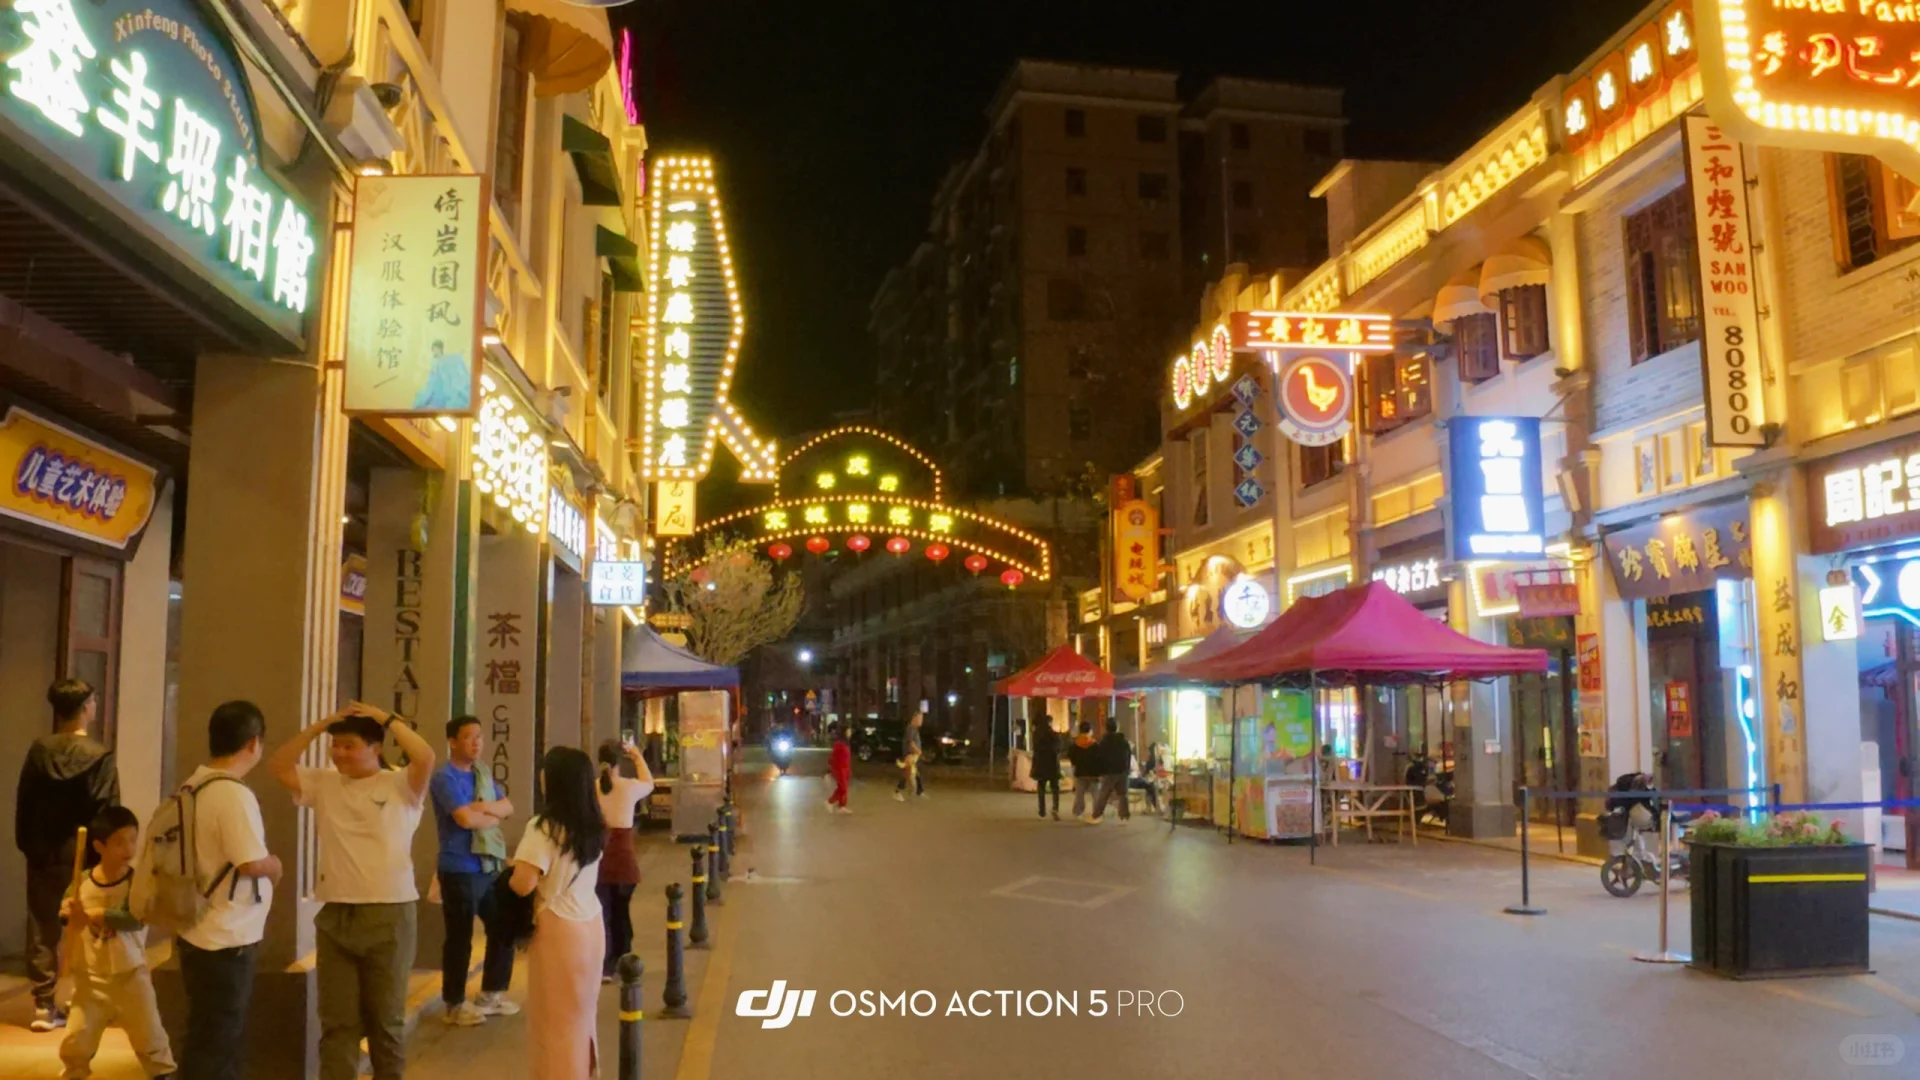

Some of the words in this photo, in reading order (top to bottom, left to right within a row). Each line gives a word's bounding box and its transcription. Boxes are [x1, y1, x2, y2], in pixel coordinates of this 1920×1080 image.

[113, 8, 180, 42] Xinfeng
[182, 25, 222, 81] Photo
[1710, 279, 1749, 296] WOO
[484, 611, 522, 695] 茶檔
